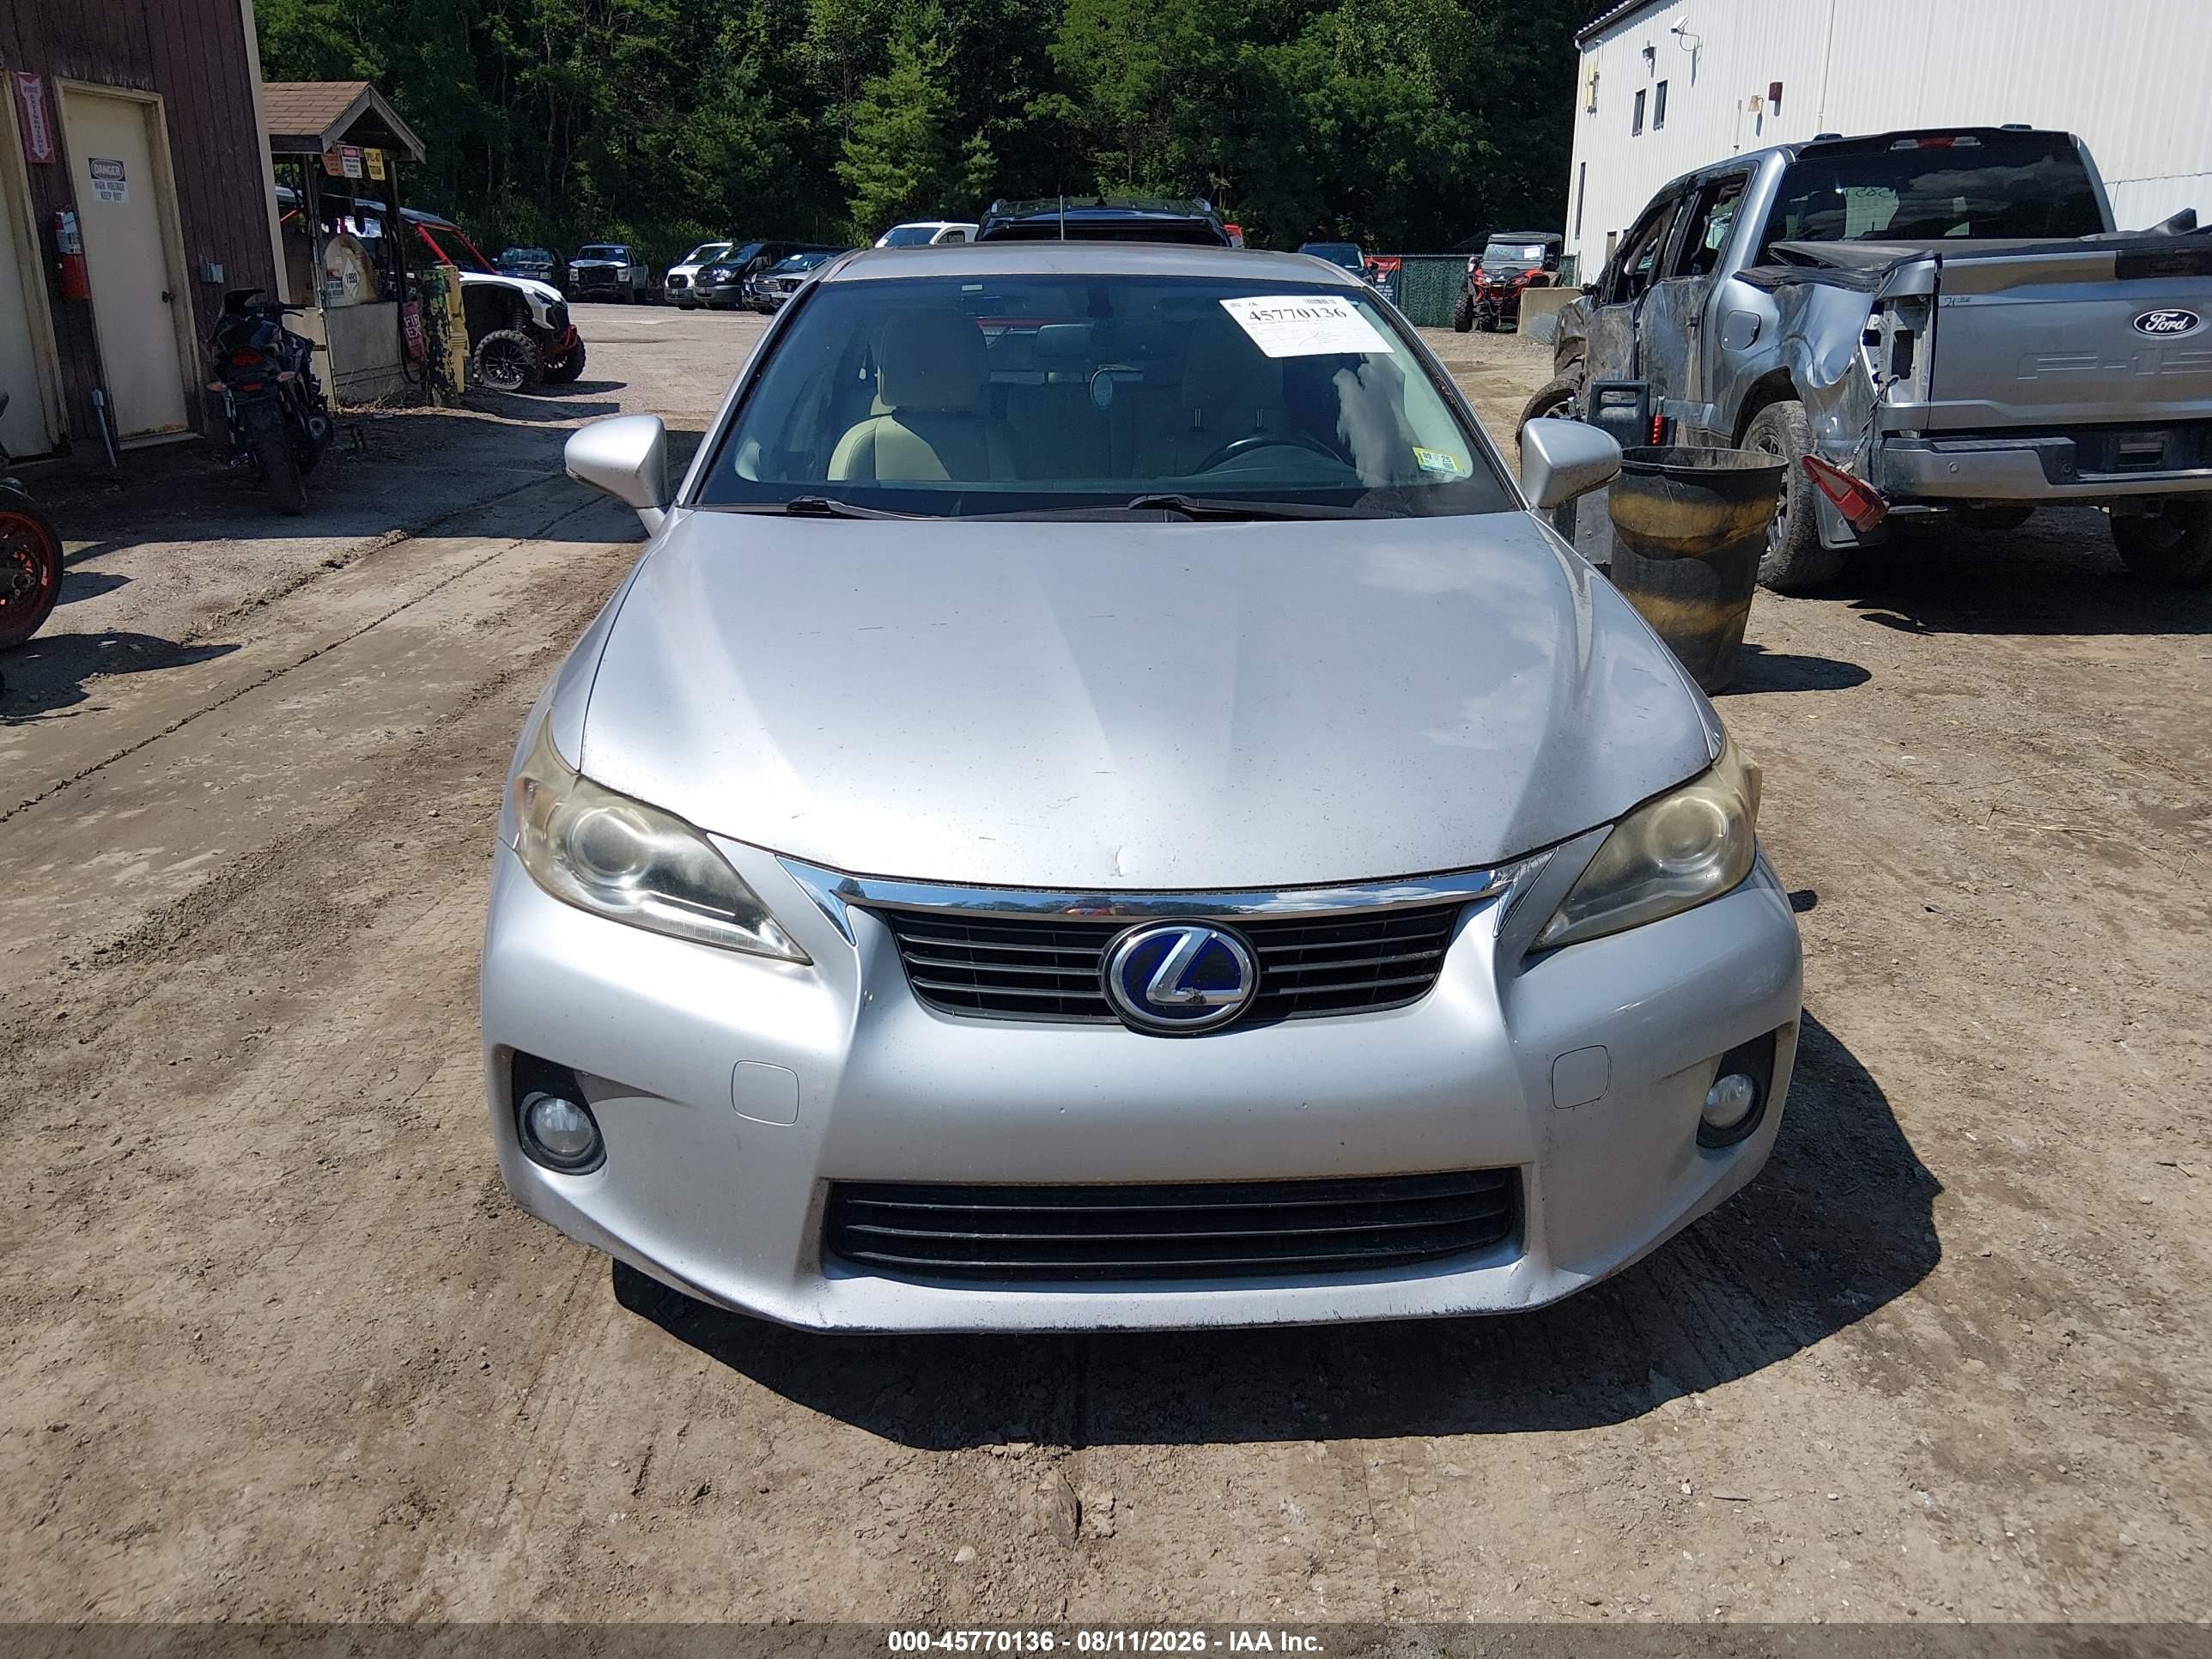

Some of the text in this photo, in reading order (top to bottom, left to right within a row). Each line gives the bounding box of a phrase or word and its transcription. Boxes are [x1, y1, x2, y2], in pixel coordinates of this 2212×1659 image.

[94, 163, 121, 176] DANGER
[1249, 307, 1347, 322] 45770136
[2145, 312, 2189, 331] Ford
